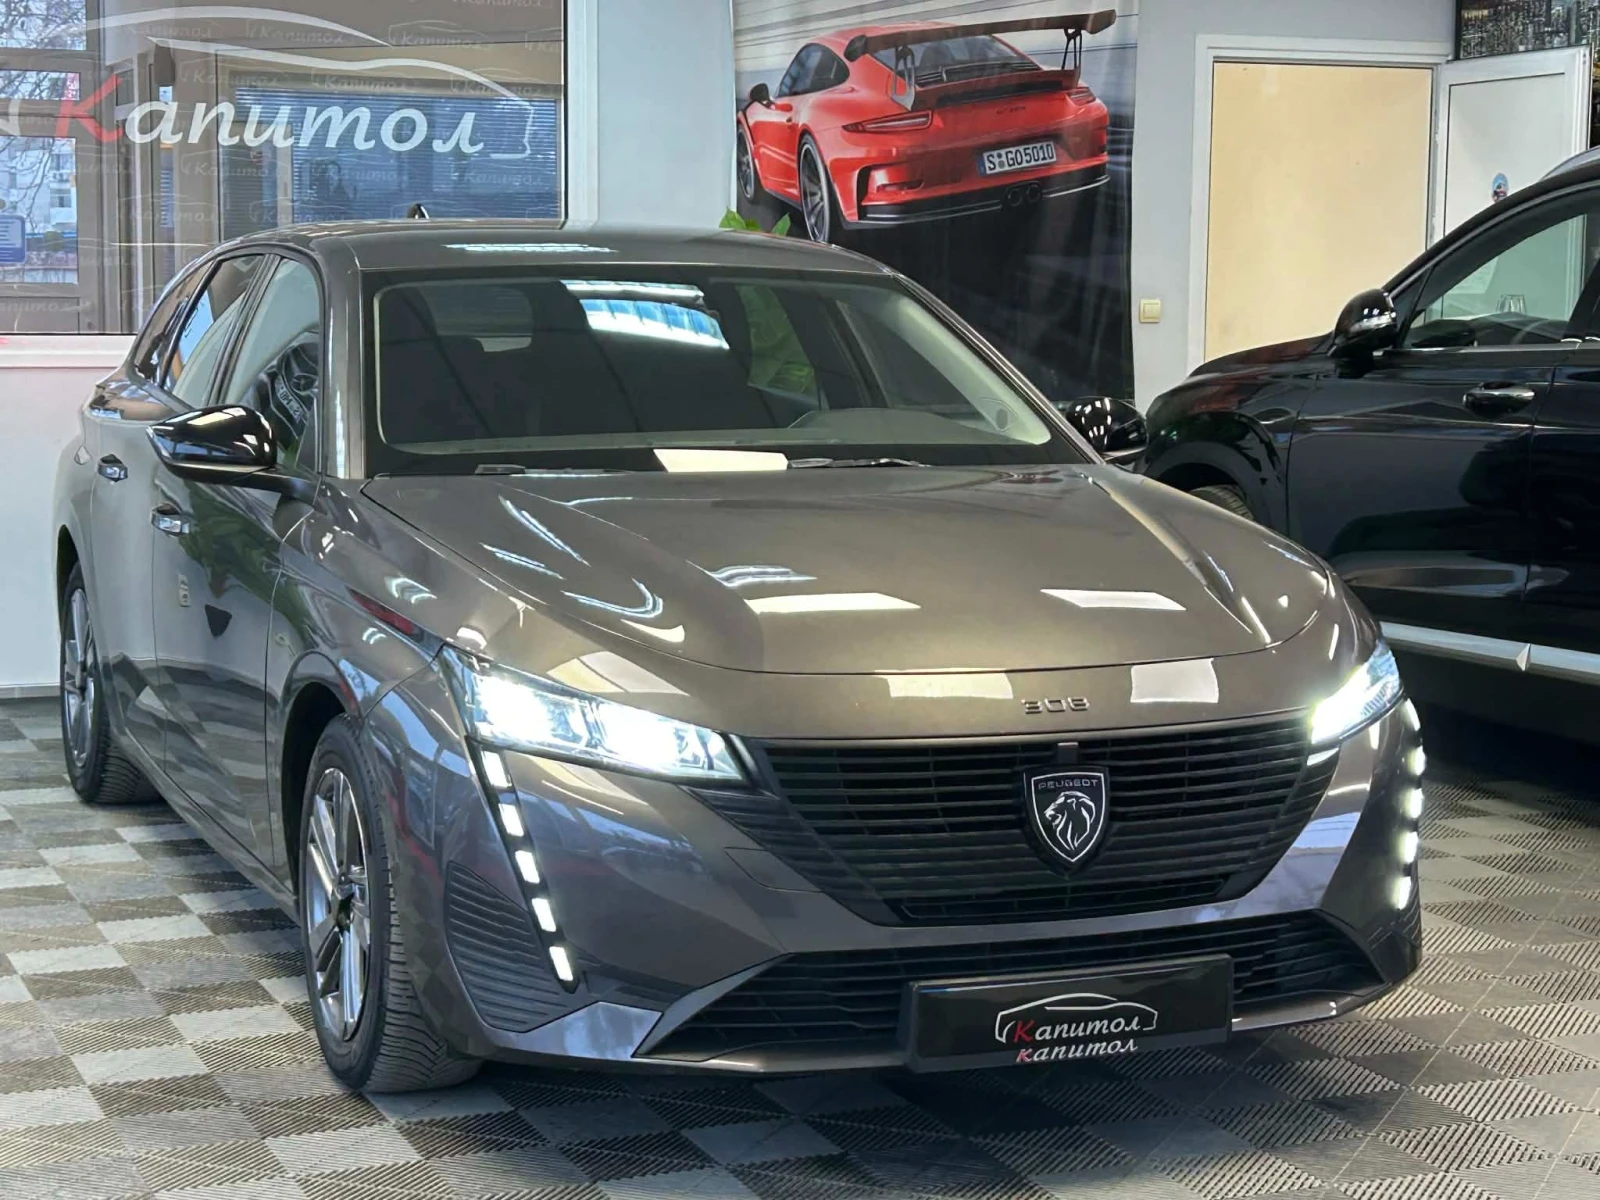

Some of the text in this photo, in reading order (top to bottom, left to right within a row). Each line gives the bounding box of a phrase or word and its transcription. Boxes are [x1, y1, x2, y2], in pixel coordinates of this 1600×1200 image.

[55, 74, 485, 153] Капитол
[1022, 697, 1090, 715] 308
[1038, 779, 1098, 790] PEUGEOT
[1013, 1016, 1140, 1043] Капитол
